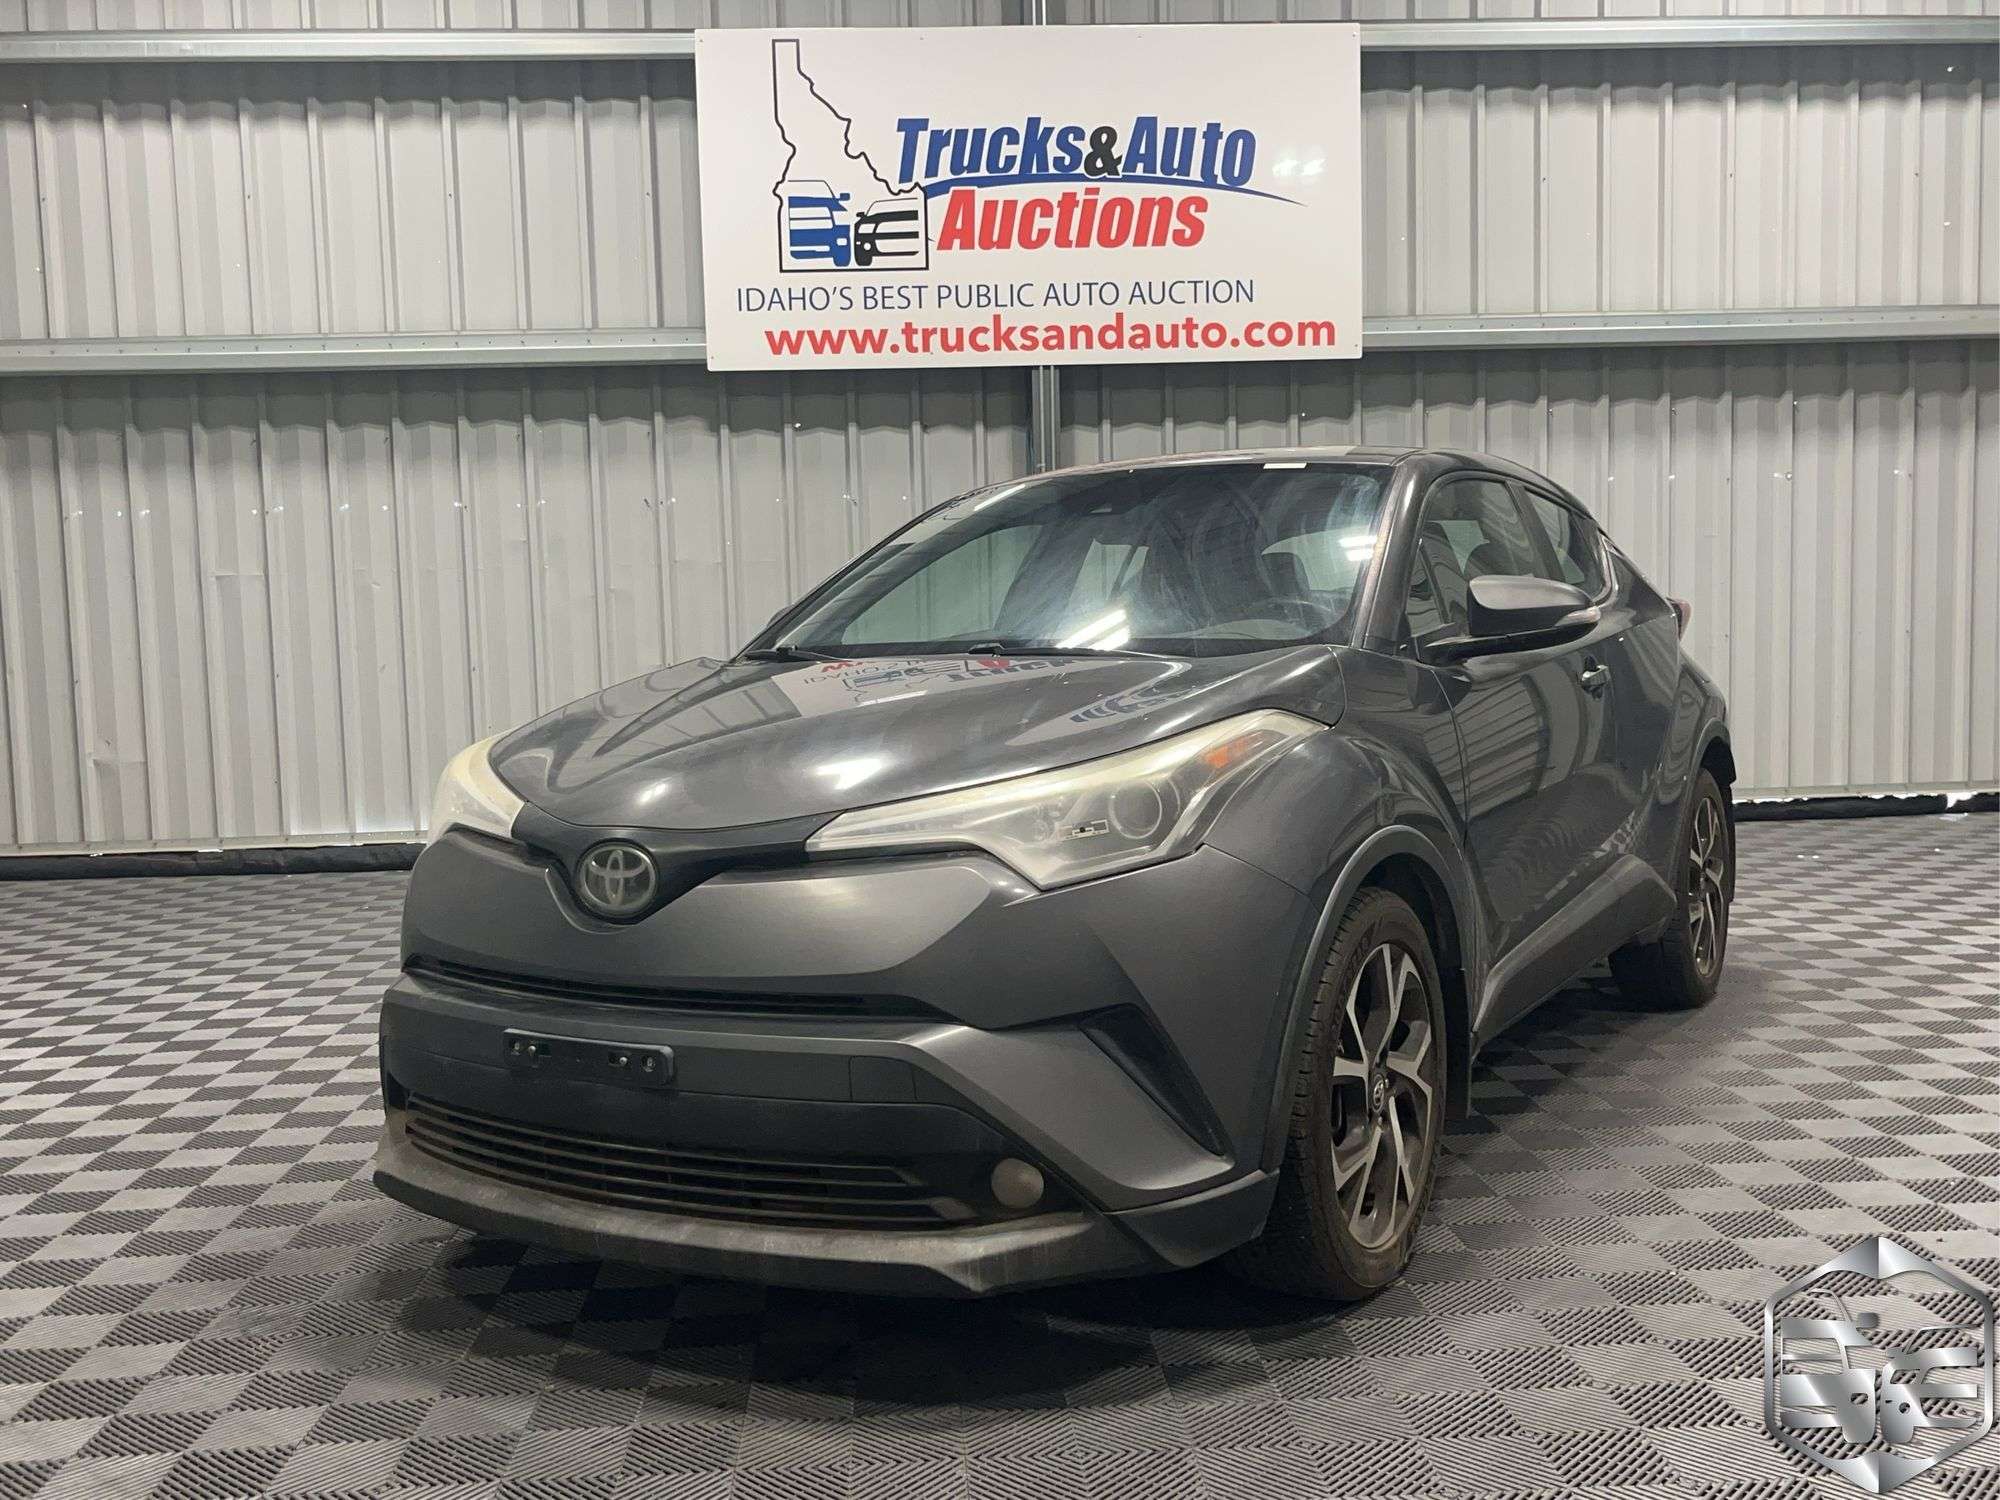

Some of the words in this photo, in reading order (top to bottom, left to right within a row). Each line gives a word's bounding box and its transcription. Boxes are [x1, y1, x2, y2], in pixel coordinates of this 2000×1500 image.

[936, 187, 1209, 250] Auctions
[737, 286, 854, 312] IDAHO'S
[863, 285, 929, 311] BEST
[937, 283, 1035, 309] PUBLIC
[1043, 281, 1120, 307] AUTO
[1128, 279, 1255, 306] AUCTION
[764, 312, 1336, 355] www.trucksandauto.com
